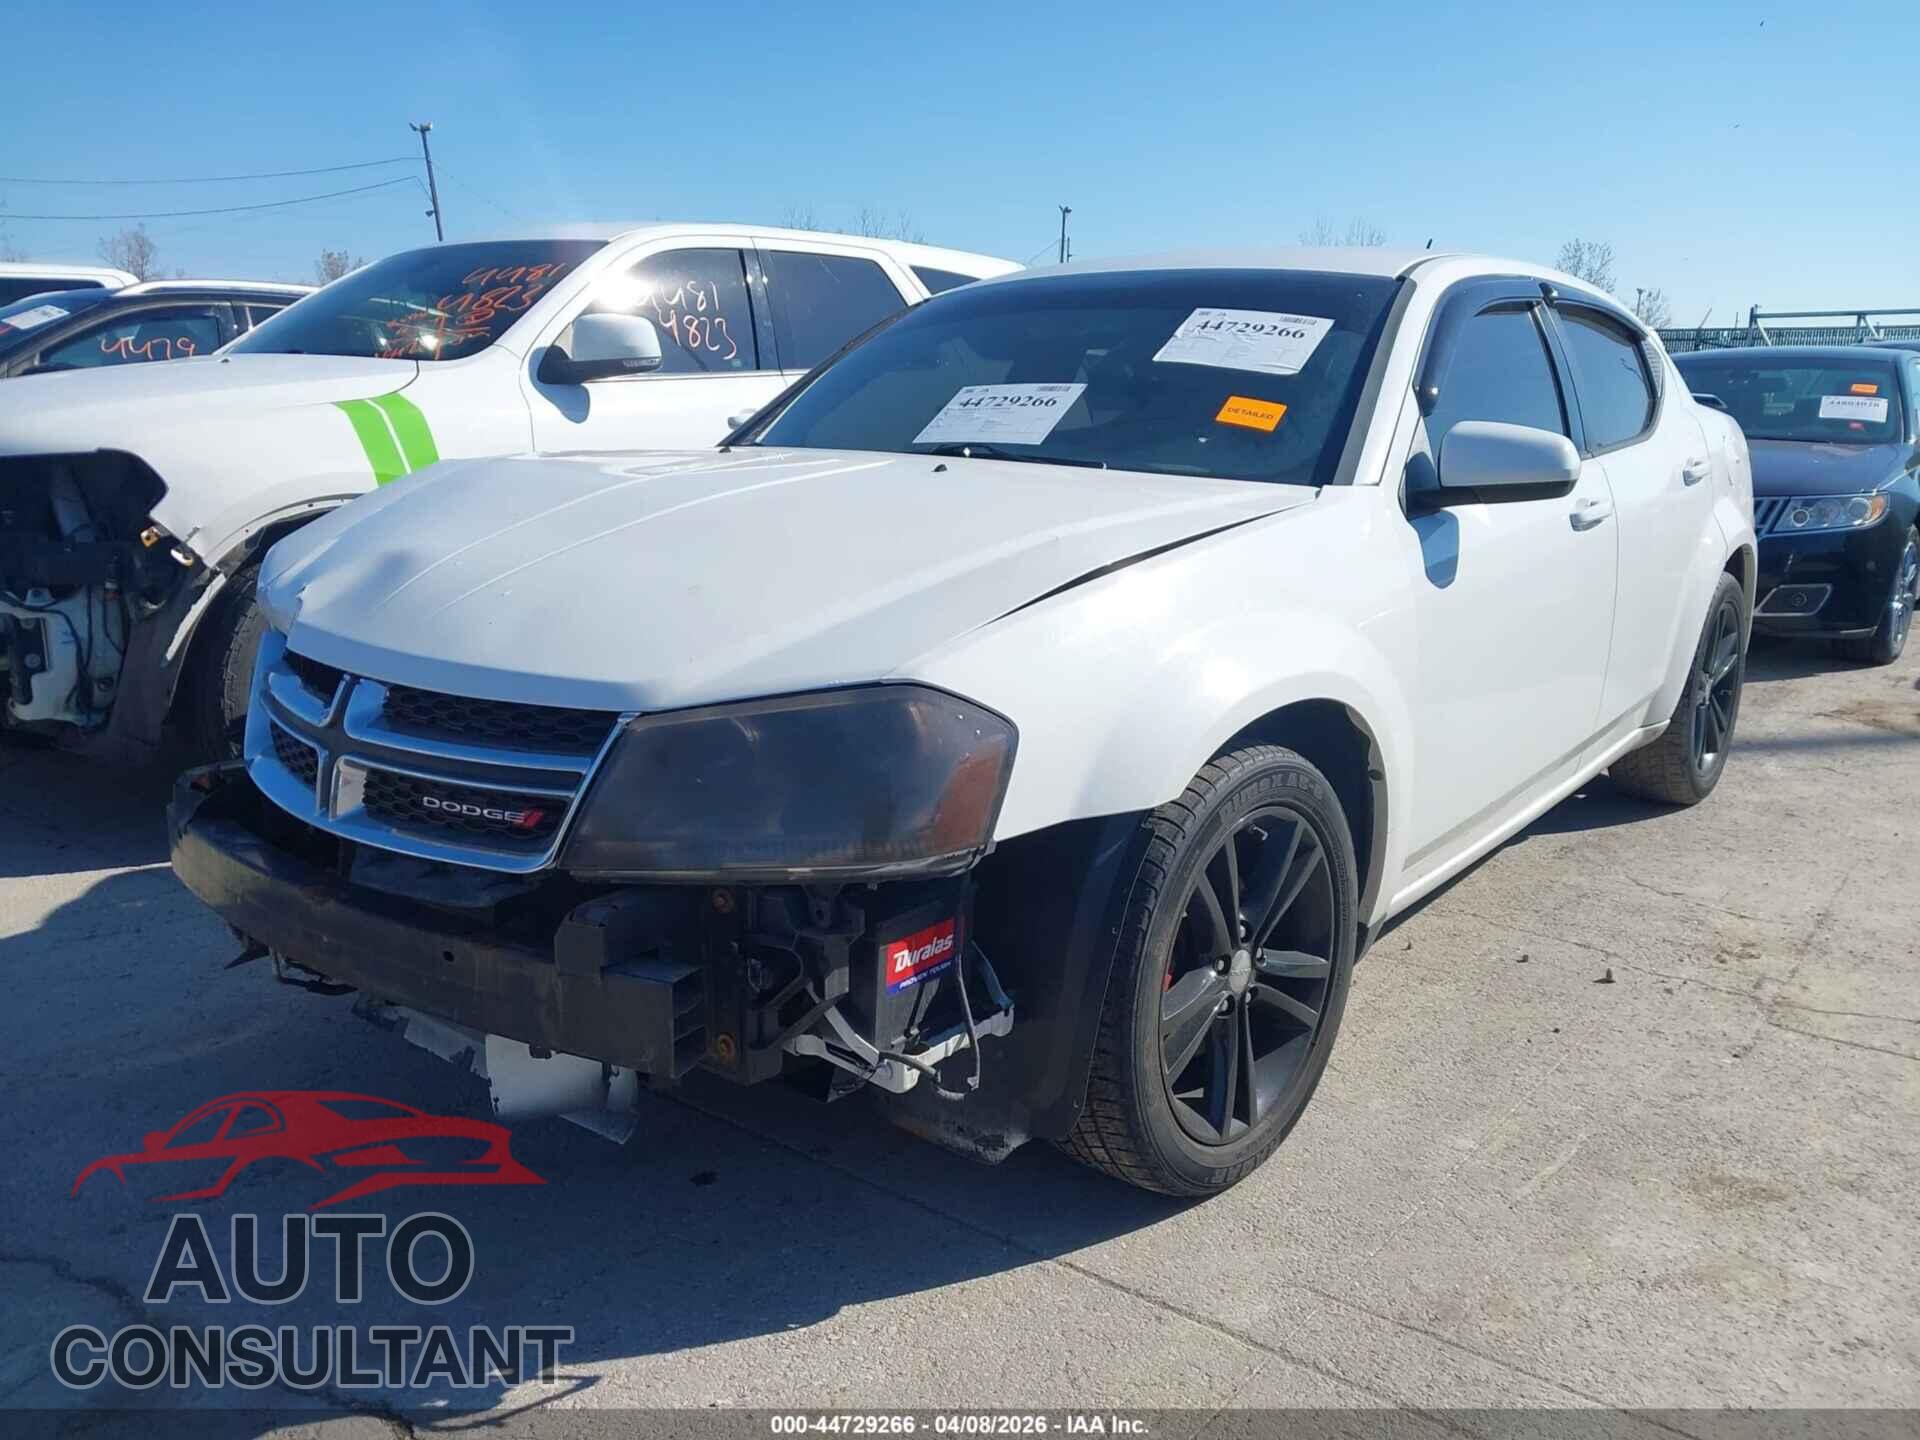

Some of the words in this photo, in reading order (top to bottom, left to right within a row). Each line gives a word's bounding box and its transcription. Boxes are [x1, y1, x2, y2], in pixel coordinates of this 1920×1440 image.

[462, 262, 568, 286] 4481
[437, 284, 545, 312] 4823
[658, 309, 737, 360] 4823
[1196, 319, 1305, 339] 44729266
[100, 335, 196, 360] 4479
[959, 395, 1057, 408] 44729266
[1227, 406, 1274, 420] DETAILED
[422, 796, 526, 823] DODGE
